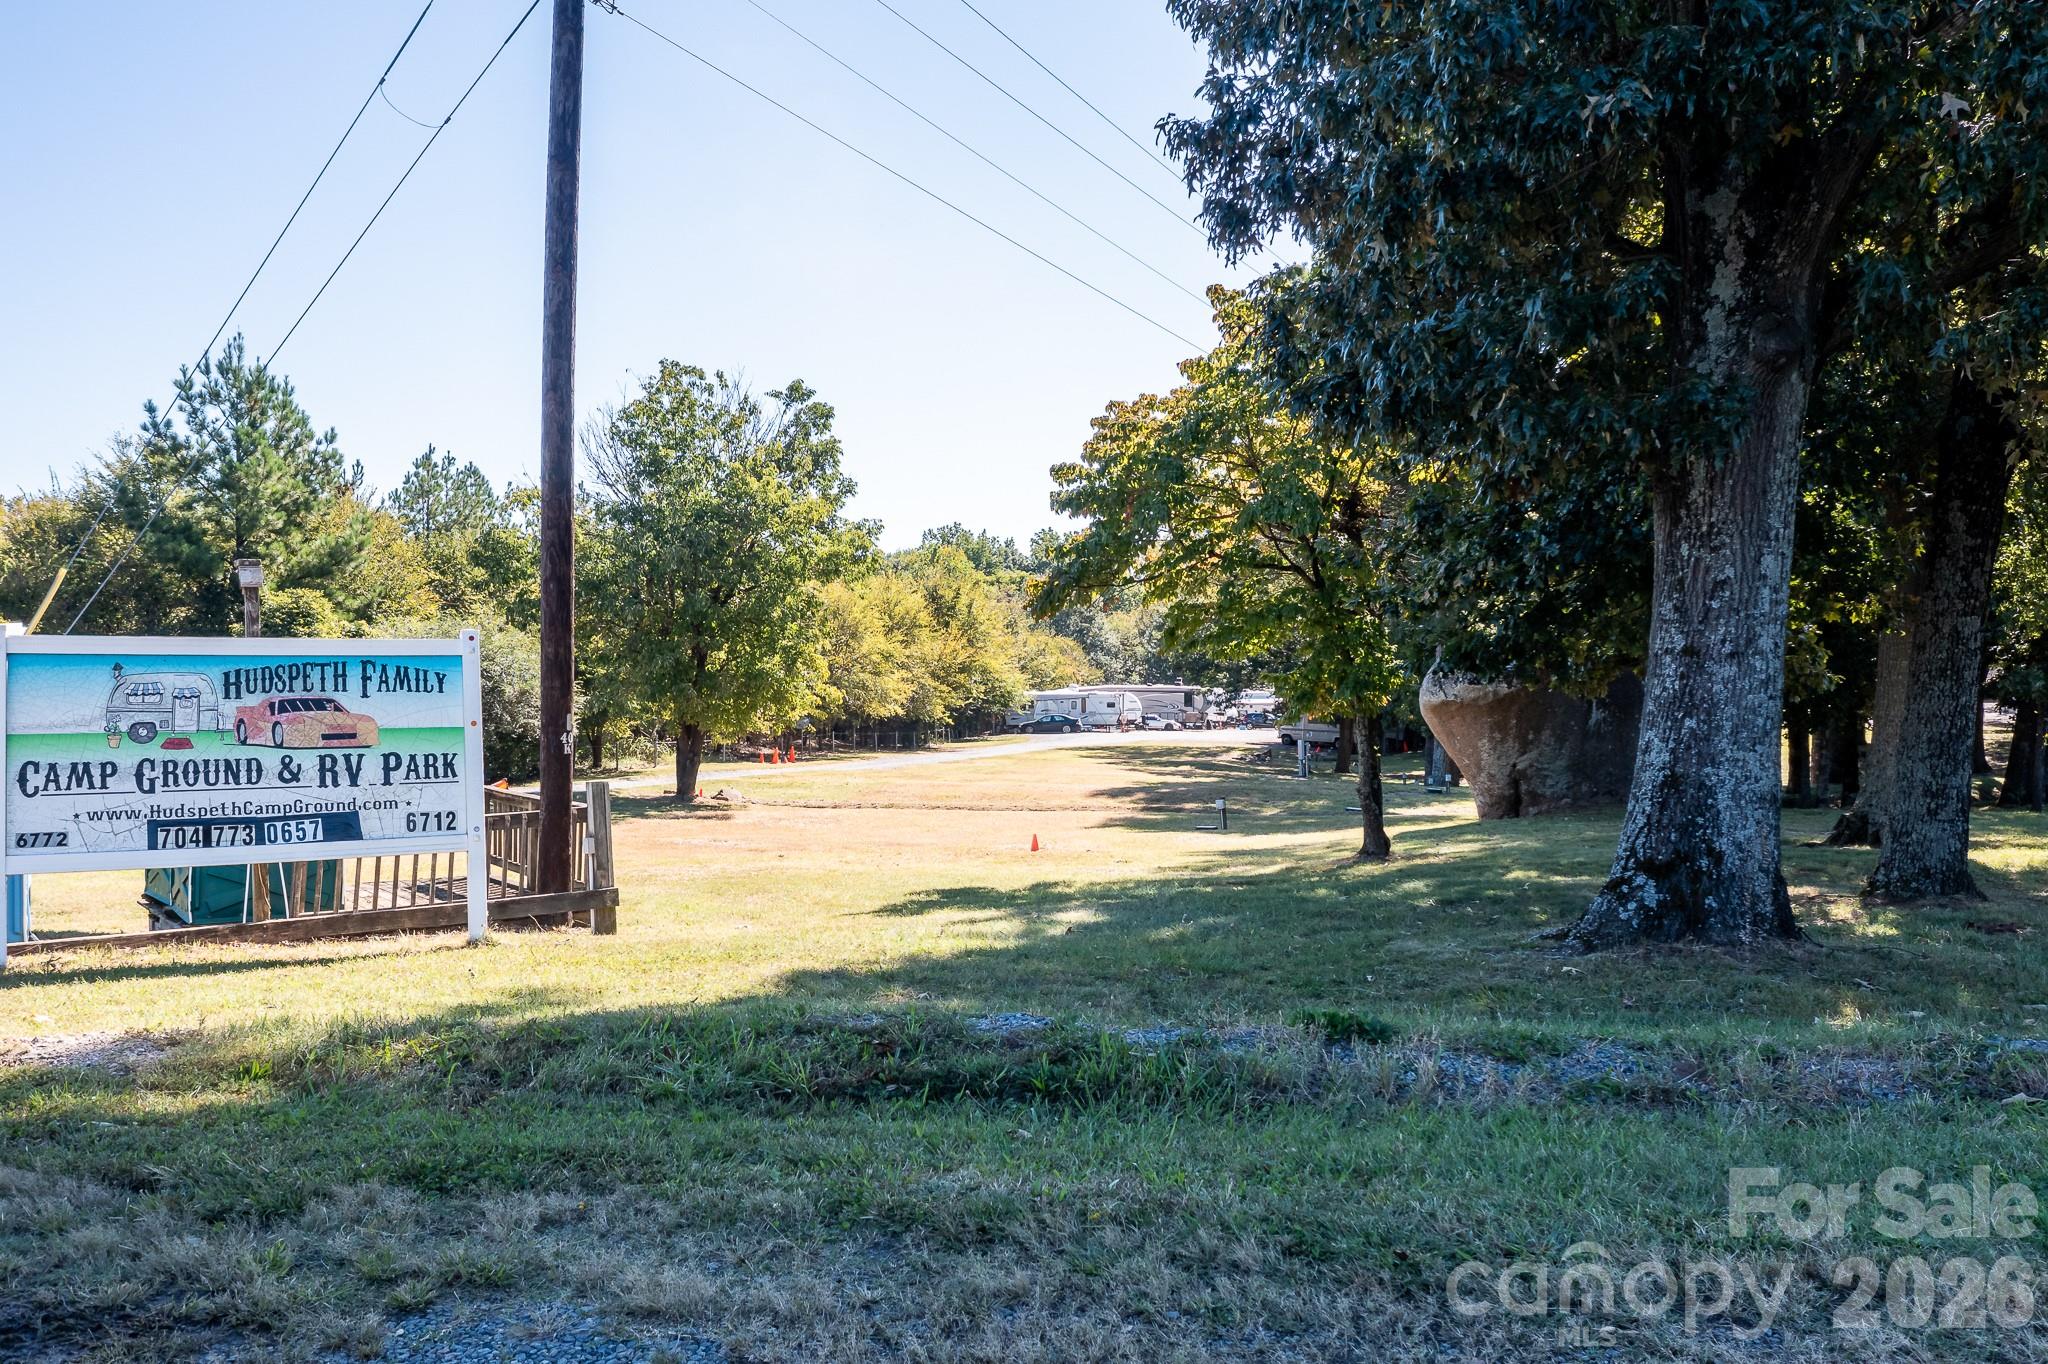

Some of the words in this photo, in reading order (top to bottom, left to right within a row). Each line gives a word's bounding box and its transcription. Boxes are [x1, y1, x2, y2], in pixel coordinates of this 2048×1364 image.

[222, 661, 349, 699] HUDSPETH
[360, 660, 447, 698] FAMILY
[17, 760, 118, 798] CAMP
[134, 757, 263, 794] GROUND
[277, 754, 302, 784] &
[316, 753, 366, 788] RV
[380, 751, 458, 786] PARK
[87, 798, 399, 821] www.HudspethCampGround.com
[406, 811, 457, 832] 6712
[16, 832, 68, 848] 6772
[159, 827, 202, 849] 704
[213, 825, 254, 847] 773
[266, 819, 321, 844] 0657
